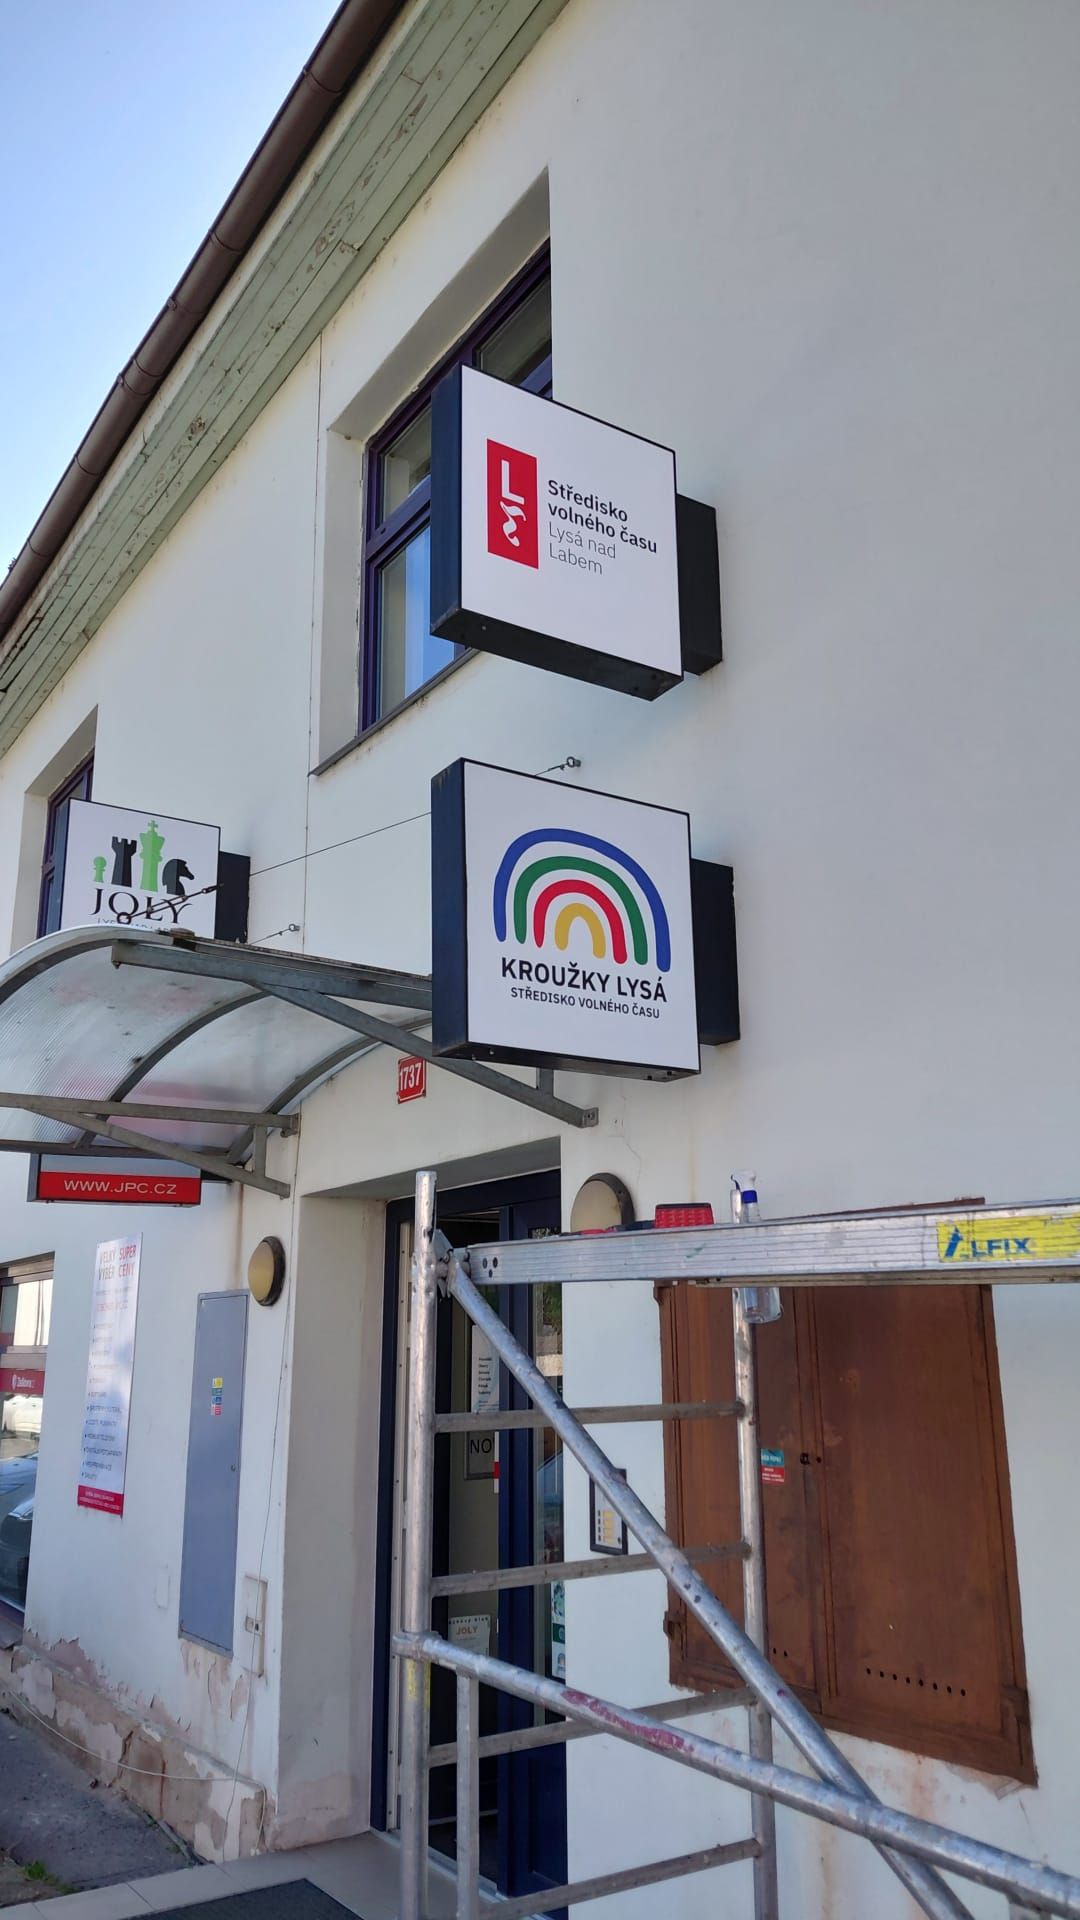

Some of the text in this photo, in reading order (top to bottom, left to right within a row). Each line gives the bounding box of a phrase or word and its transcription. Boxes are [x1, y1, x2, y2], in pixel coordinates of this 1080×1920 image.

[547, 479, 628, 522] Středisko
[547, 503, 657, 554] volného času
[549, 521, 617, 559] Lysá nad
[549, 543, 603, 575] Labem
[88, 888, 193, 924] JOLY
[501, 957, 668, 1003] KROUŽKY LYSÁ
[510, 986, 660, 1019] STŘEDISKO VOLNÉHO ČASU
[400, 1062, 422, 1091] 1737
[63, 1180, 177, 1195] WWW.JPC.CZ
[470, 1437, 495, 1454] NO
